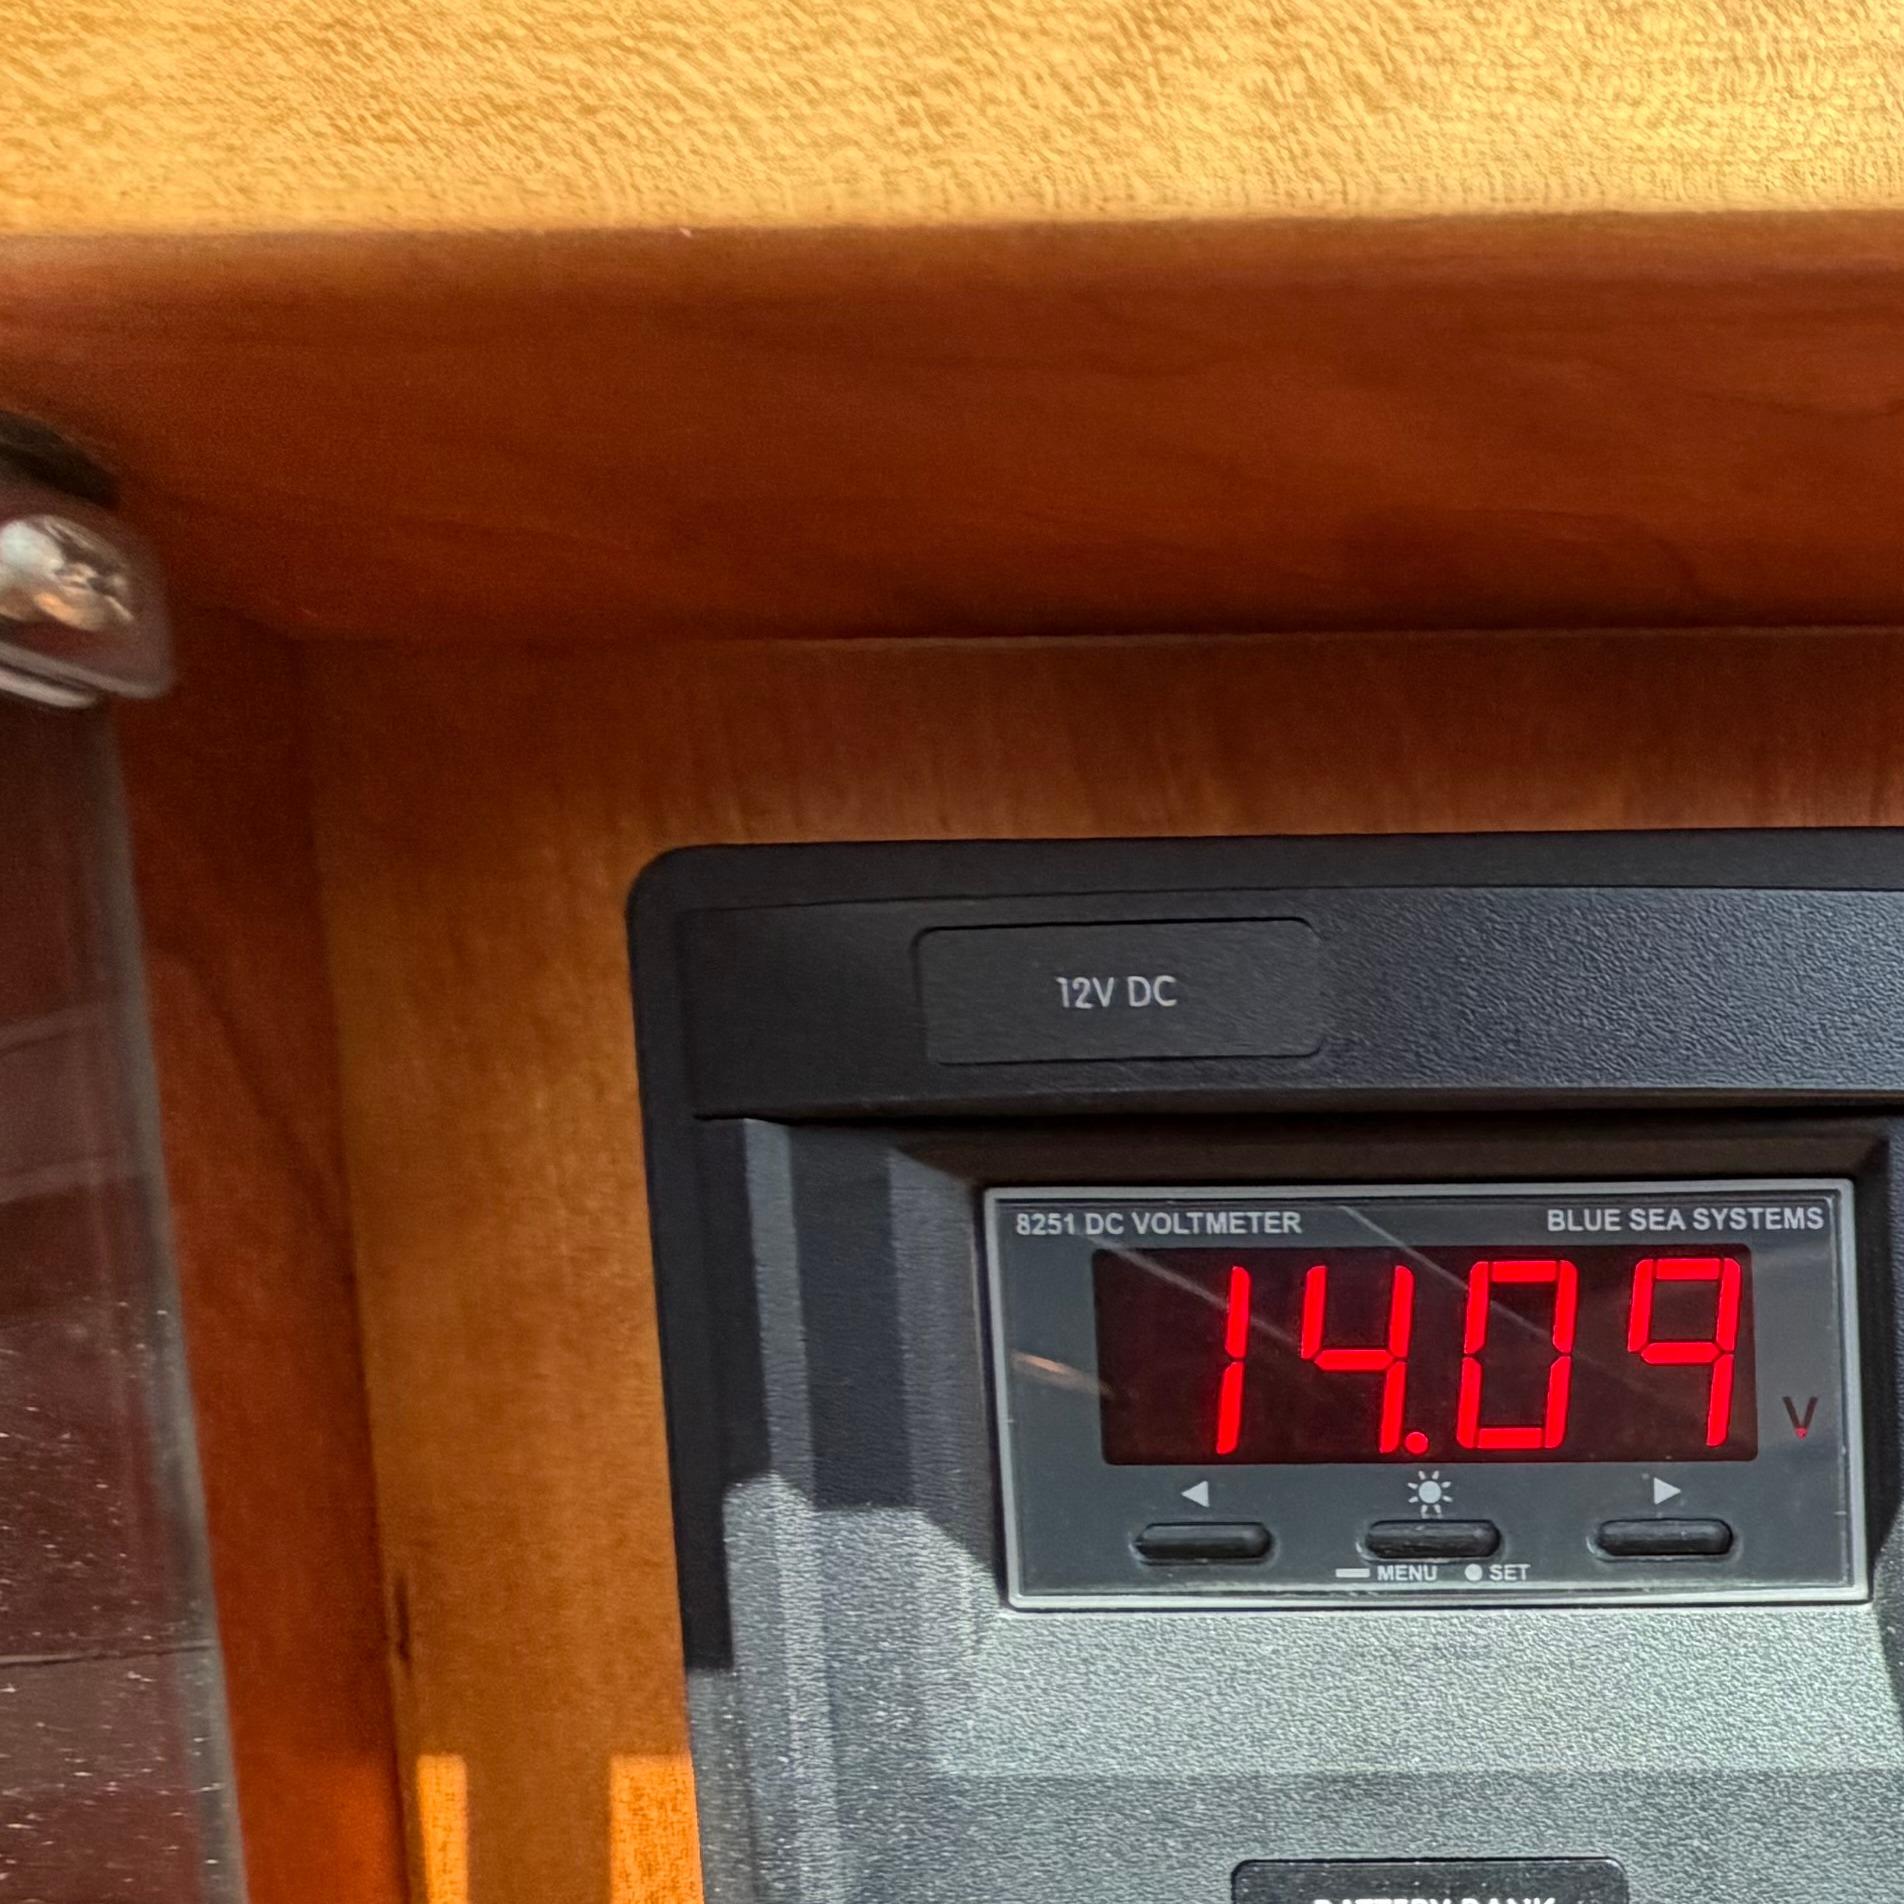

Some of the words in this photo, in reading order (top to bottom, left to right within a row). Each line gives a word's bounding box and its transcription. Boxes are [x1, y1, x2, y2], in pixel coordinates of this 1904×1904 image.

[1056, 976, 1115, 1009] 12V
[1127, 974, 1177, 1007] DC
[1016, 1212, 1076, 1236] 8251
[1084, 1212, 1124, 1235] DC
[1131, 1211, 1303, 1235] VOLTMETER
[1547, 1208, 1622, 1232] BLUE
[1629, 1207, 1687, 1231] SEA
[1692, 1206, 1824, 1231] SYSTEMS
[1215, 1257, 1742, 1456] 14.09
[1783, 1395, 1820, 1440] V
[1376, 1563, 1439, 1583] MENU
[1487, 1563, 1531, 1583] SET
